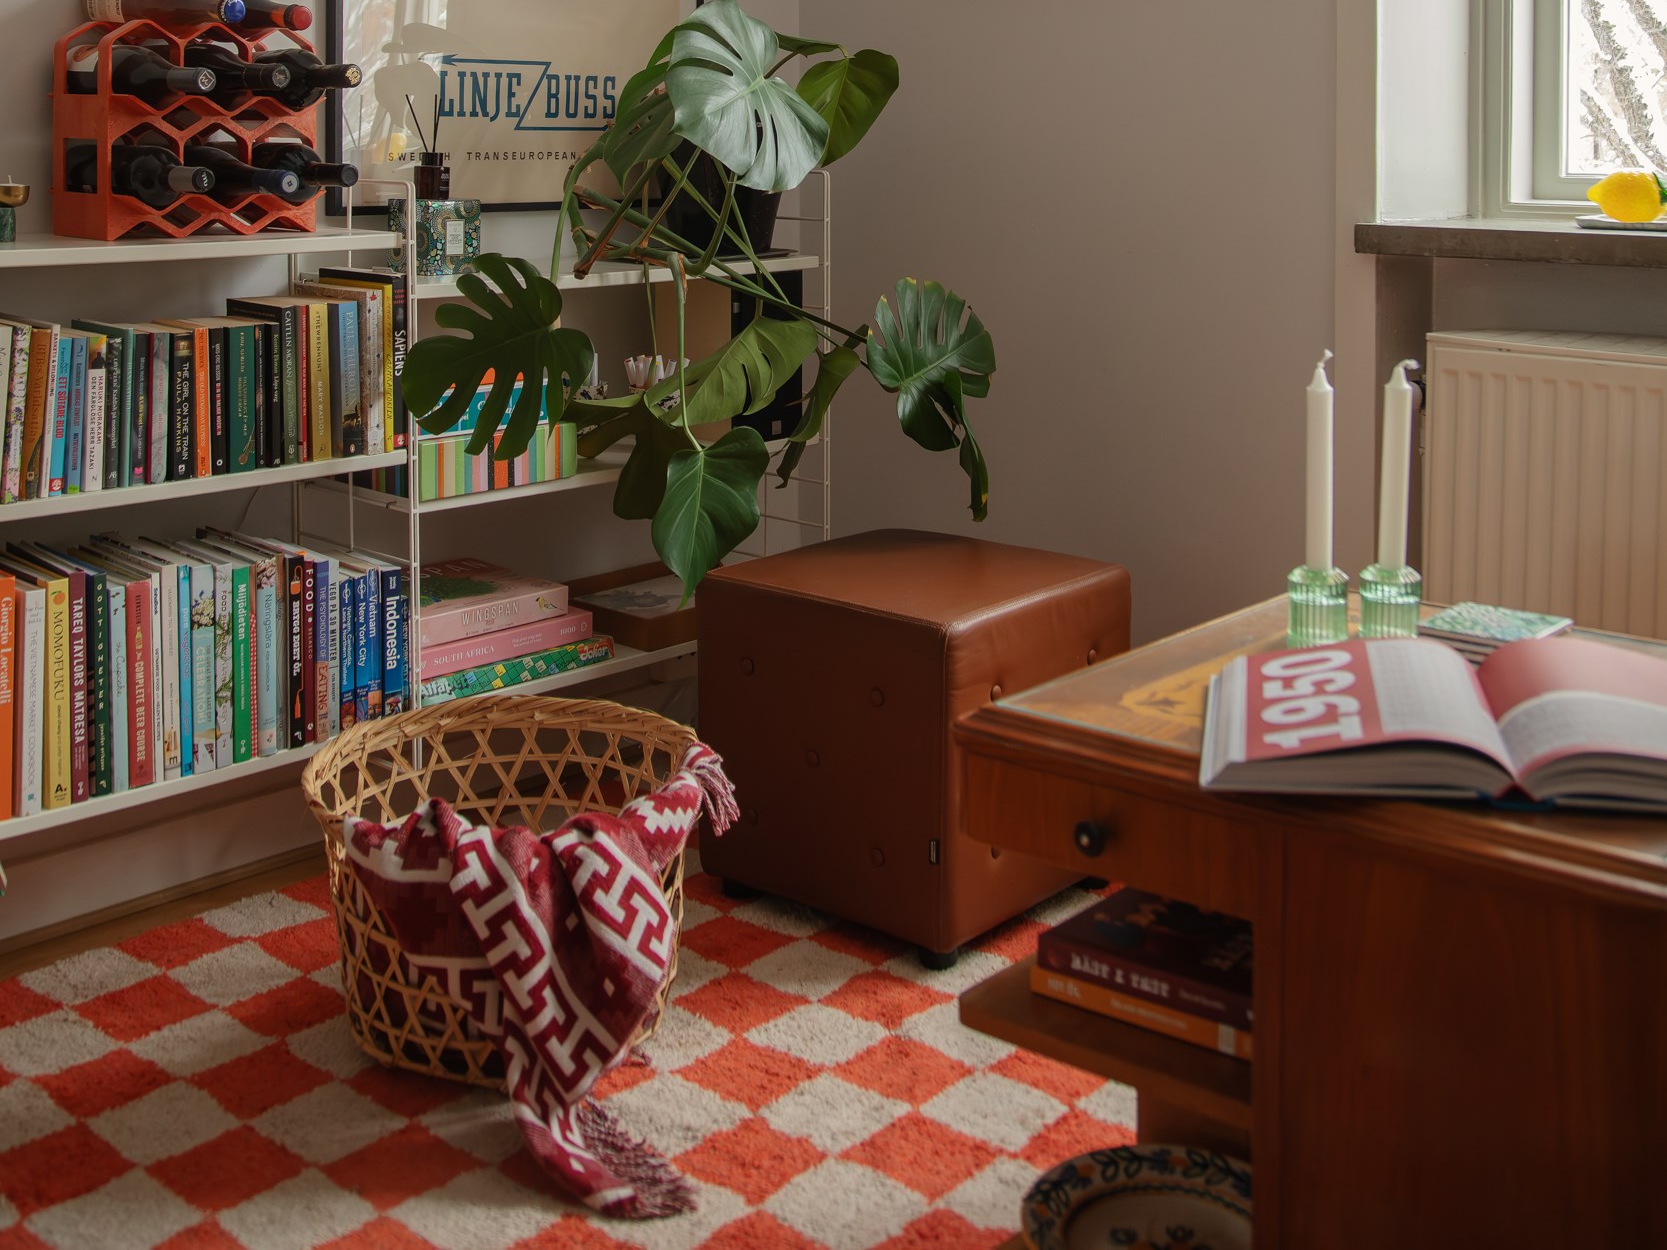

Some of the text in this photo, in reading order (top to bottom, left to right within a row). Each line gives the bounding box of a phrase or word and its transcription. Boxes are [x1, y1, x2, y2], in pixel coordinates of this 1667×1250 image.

[439, 70, 617, 123] LINJE BUSS
[388, 151, 577, 161] SWEDH TRANSEUROPEAN
[285, 311, 293, 378] CAITLIN MORAN
[346, 311, 356, 406] PAUL THEROUX
[394, 329, 407, 377] SAPIENS
[56, 391, 67, 419] SÖTARE
[57, 376, 67, 390] ETT
[182, 402, 189, 414] ON
[88, 426, 96, 445] HERR
[235, 582, 247, 641] Miljödieten
[305, 568, 314, 613] FOOD
[319, 586, 327, 601] THE
[358, 602, 367, 623] New
[72, 597, 85, 634] TAREQ
[262, 593, 274, 649] Näringslära
[319, 602, 327, 648] PSYCHOLOGY
[329, 582, 338, 662] VEGO PÅ 30 MINUTER
[359, 624, 367, 646] York
[368, 593, 379, 639] Vietnam
[386, 595, 401, 670] Indonesia
[461, 601, 520, 626] WINGSPAN
[0, 596, 13, 705] Giorgio Locatelli
[53, 611, 65, 701] MOMOFUKU
[181, 606, 191, 681] pure vegetarian
[292, 600, 303, 676] BRYGG EGET ÖL
[319, 649, 327, 659] OF
[357, 647, 367, 668] City
[433, 645, 496, 668] SOUTH AFRICA
[29, 648, 38, 698] VIETNAMESE
[73, 639, 85, 687] TAYLORS
[114, 654, 125, 698] Cupcake
[135, 661, 144, 706] COMPLETE
[195, 645, 206, 725] CELEBRATIONS
[318, 666, 328, 711] EATING
[1260, 649, 1365, 750] 1950
[28, 701, 37, 734] MARKET
[74, 691, 86, 744] MATRESA
[136, 707, 145, 728] BEER
[136, 729, 146, 762] COURSE
